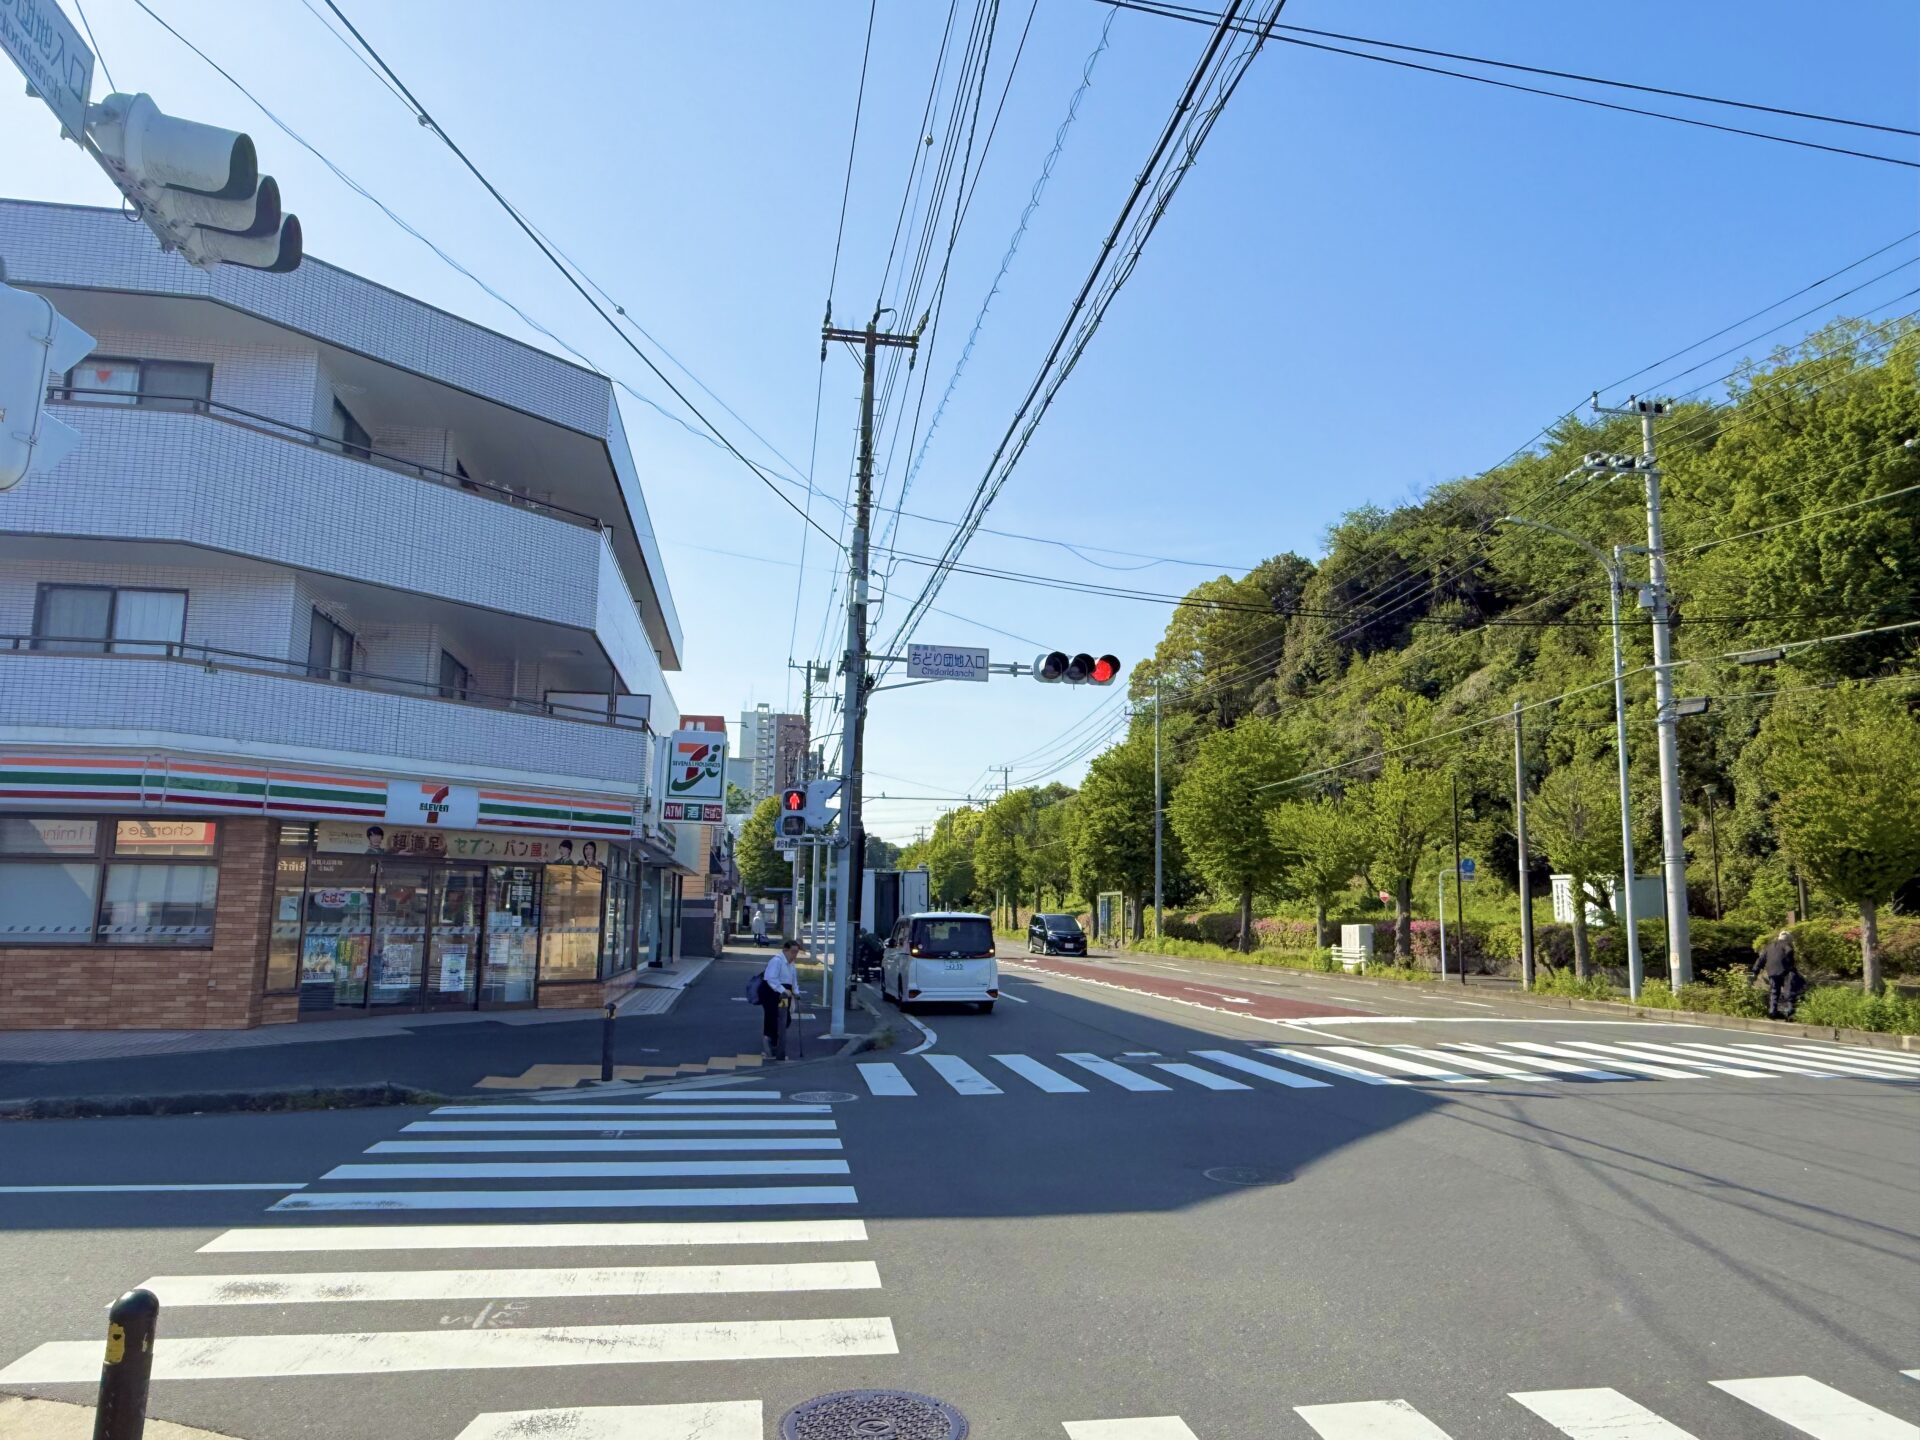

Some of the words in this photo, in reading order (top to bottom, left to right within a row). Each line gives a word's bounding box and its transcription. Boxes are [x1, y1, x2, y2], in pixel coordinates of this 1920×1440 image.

[2, 0, 86, 103] 団地入口
[912, 651, 985, 669] ちどり団地入口
[921, 667, 975, 677] Chidoridanchi
[664, 805, 682, 818] ATM
[687, 806, 700, 819] 酒
[704, 806, 722, 819] たばこ
[321, 892, 346, 904] たばこ
